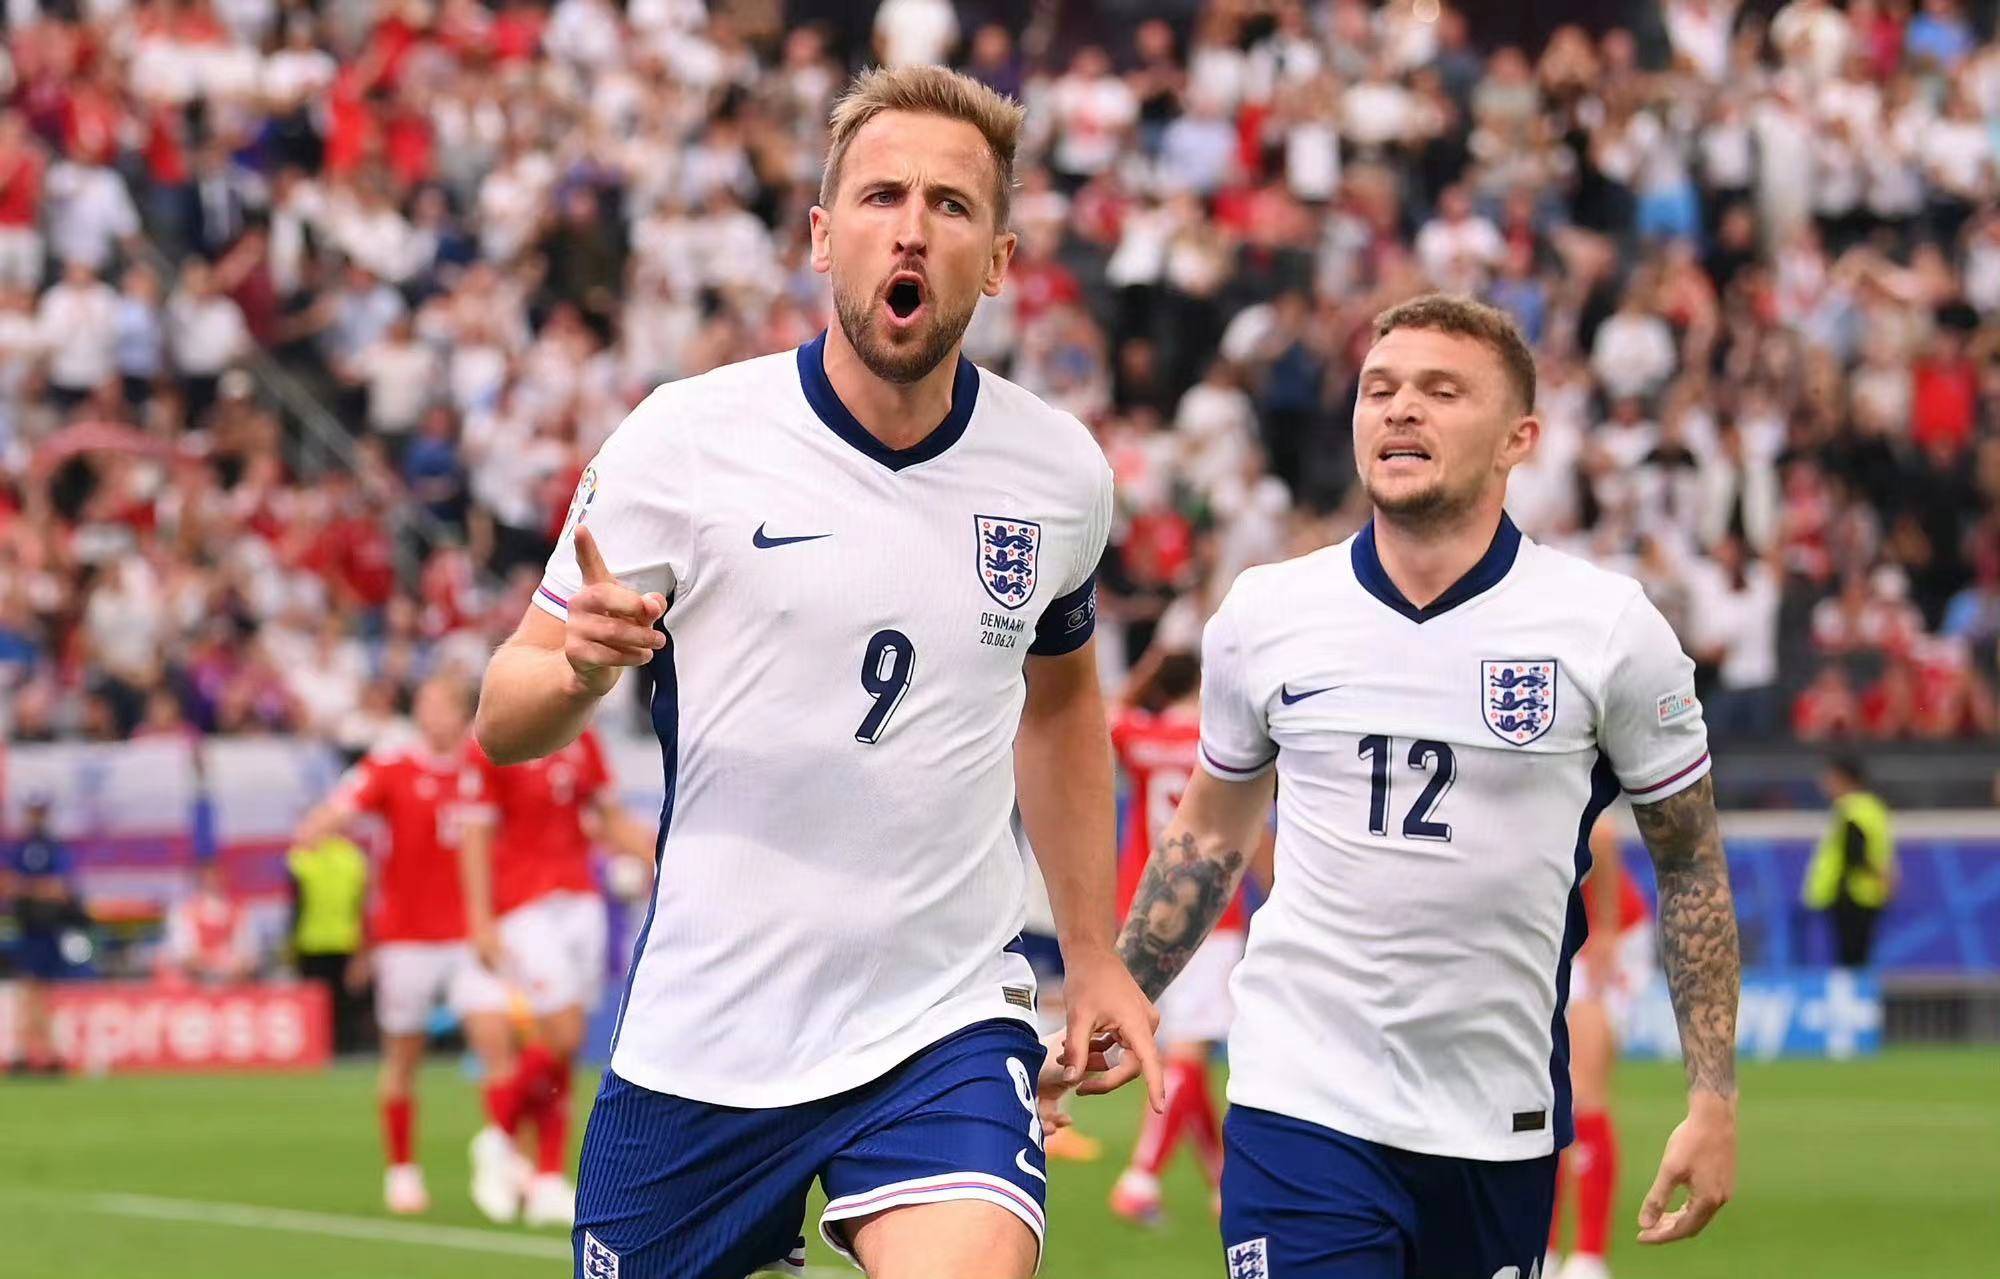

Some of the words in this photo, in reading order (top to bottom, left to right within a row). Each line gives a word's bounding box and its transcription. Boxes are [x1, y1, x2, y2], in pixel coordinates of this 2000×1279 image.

[980, 630, 1017, 649] 20.06.24
[981, 612, 1025, 632] DENMARK
[855, 629, 916, 744] 9
[1358, 734, 1457, 843] 12
